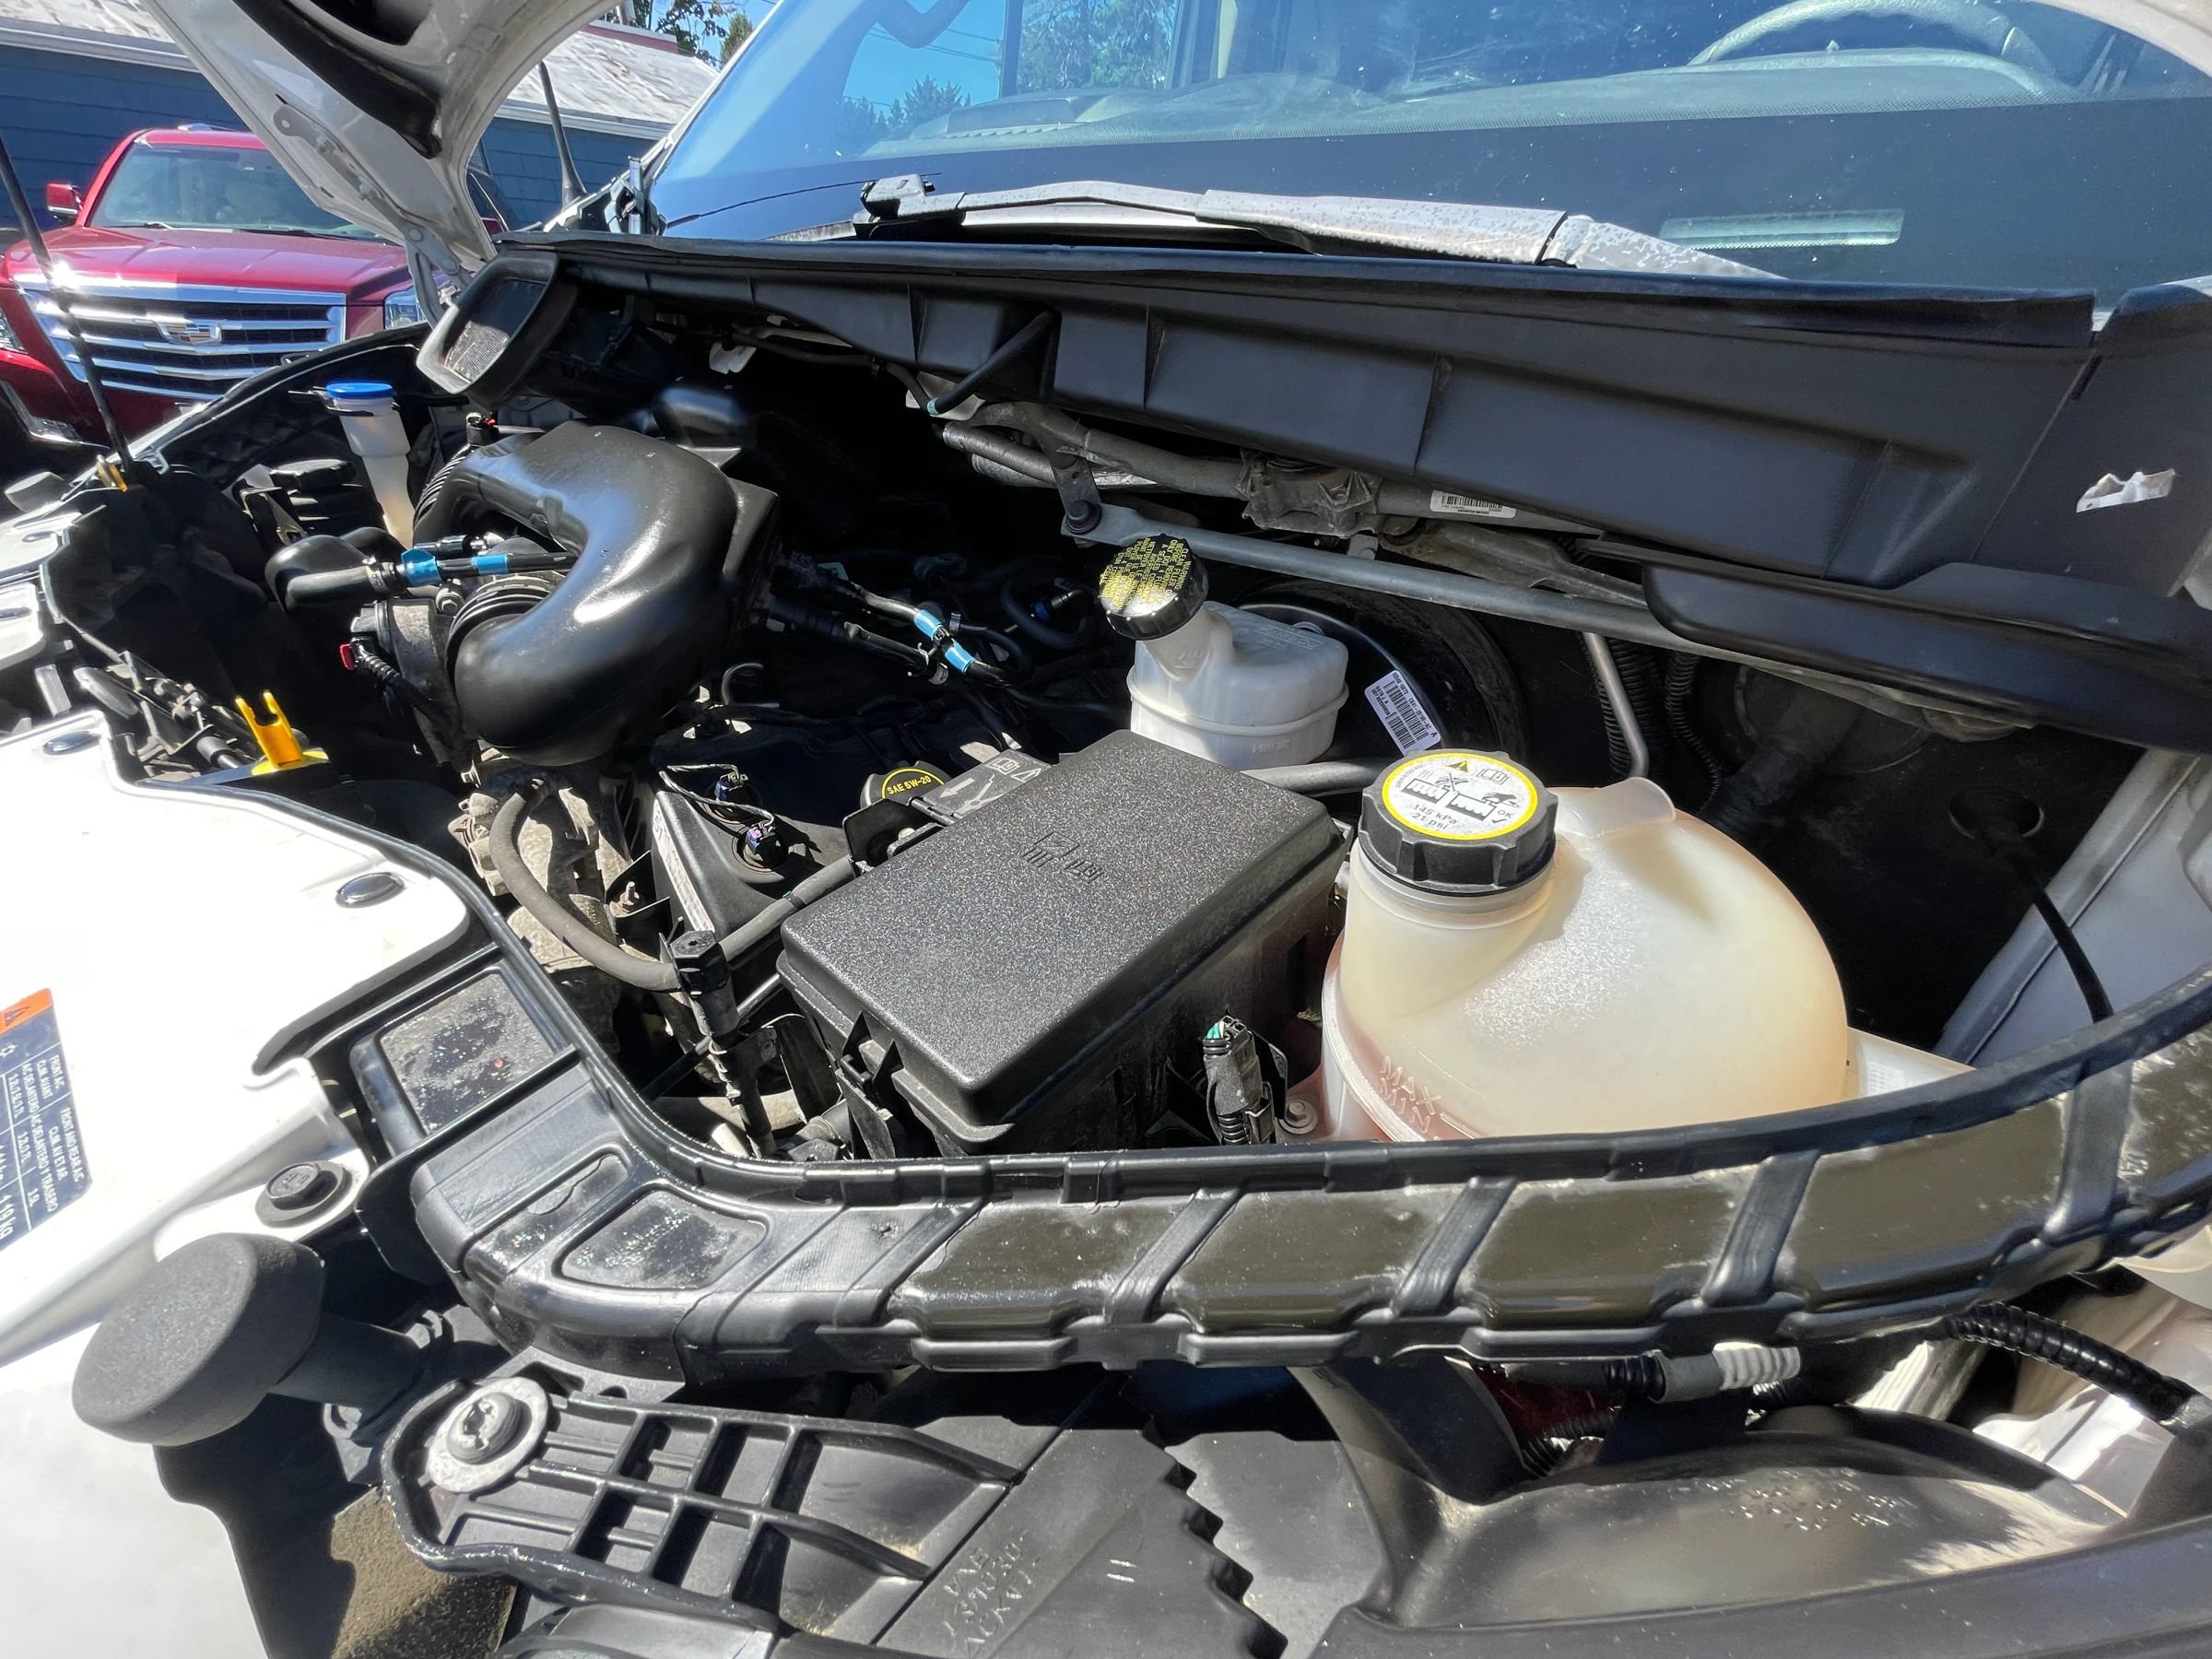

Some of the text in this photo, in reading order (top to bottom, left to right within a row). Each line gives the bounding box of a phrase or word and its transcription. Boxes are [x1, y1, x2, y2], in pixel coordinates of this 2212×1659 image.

[888, 776, 932, 794] SAE 5W-20
[1411, 812, 1449, 830] 21 psi
[1413, 804, 1460, 825] 145 kPa
[1497, 809, 1512, 818] OK
[49, 1054, 63, 1077] FRONT
[1381, 1055, 1441, 1115] MAX
[60, 1107, 74, 1131] FRONT
[31, 1124, 50, 1169] DELANTERO
[41, 1173, 58, 1211] TRASERO
